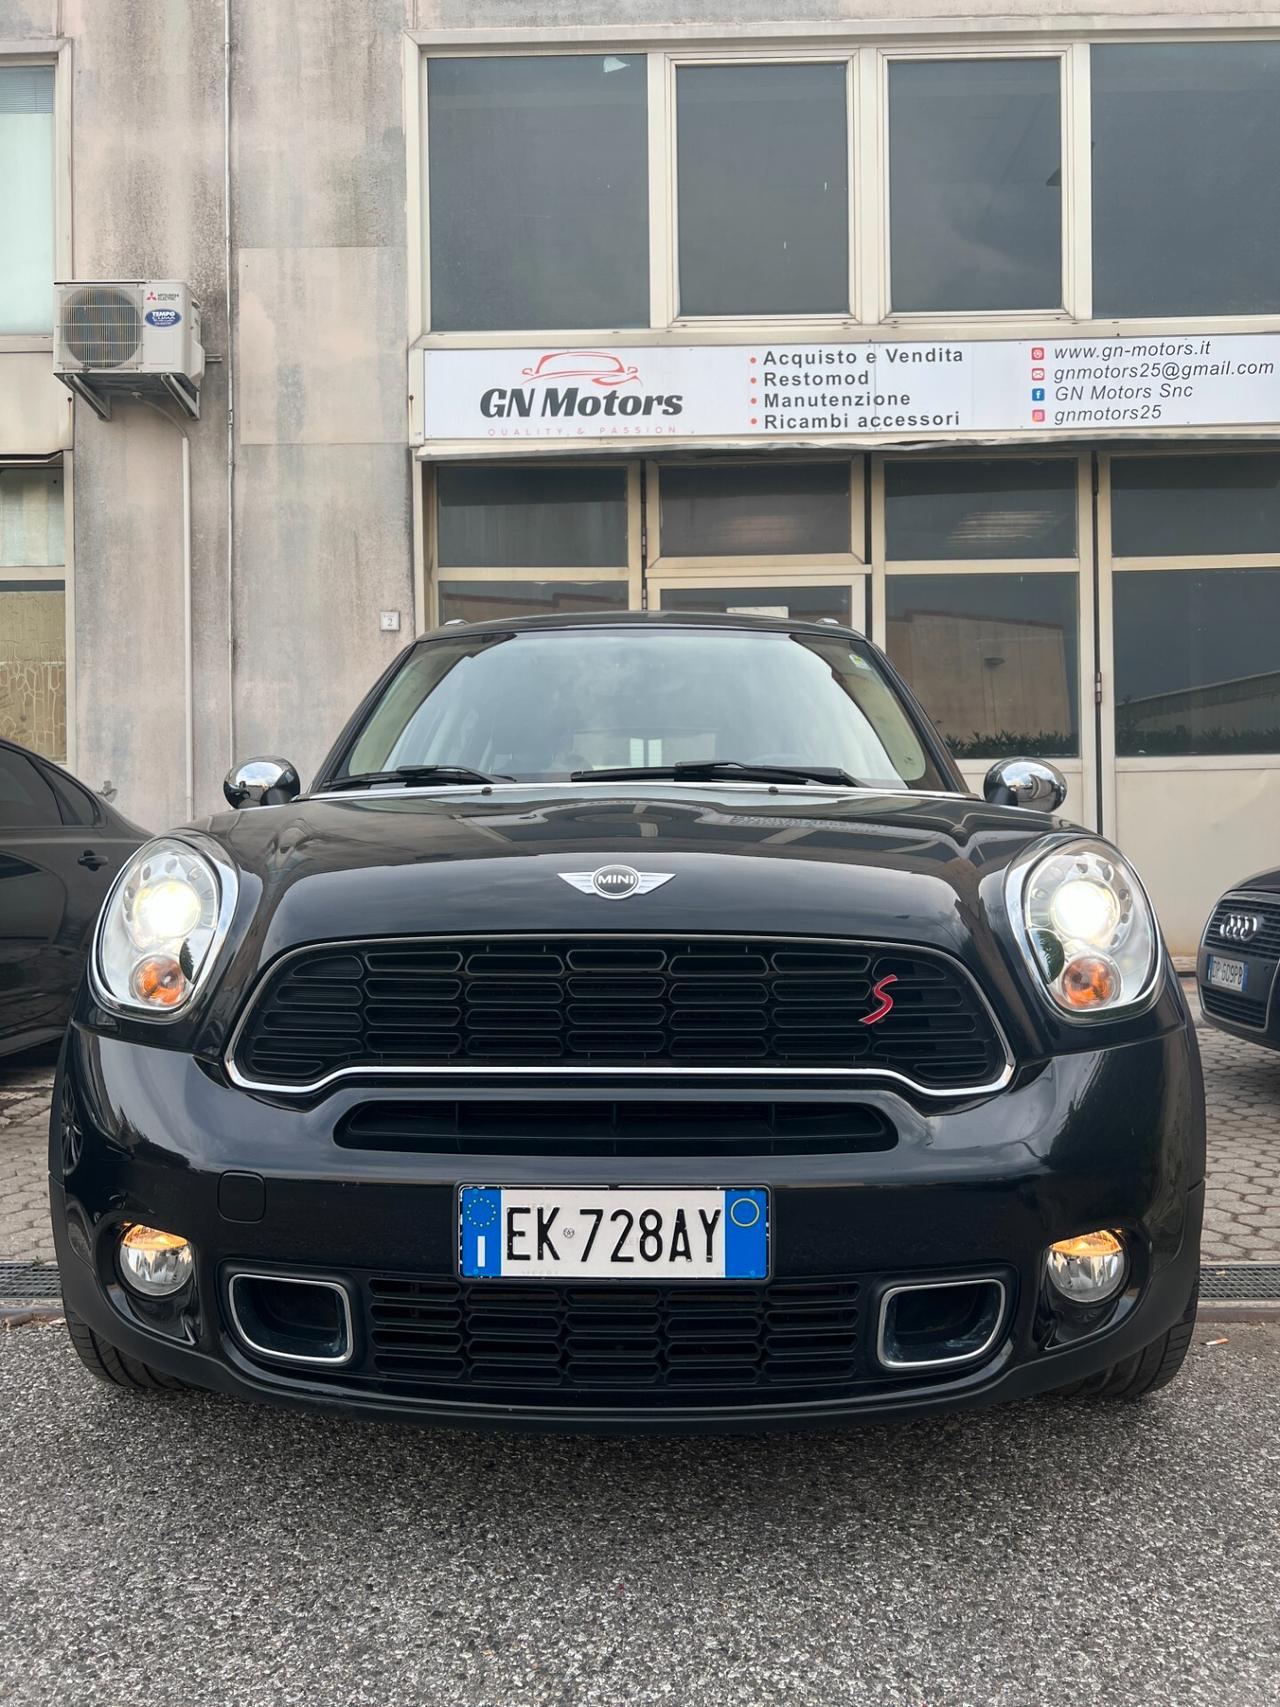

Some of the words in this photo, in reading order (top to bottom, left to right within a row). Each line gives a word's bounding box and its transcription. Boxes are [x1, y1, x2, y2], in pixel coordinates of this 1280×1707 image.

[763, 349, 857, 369] Acquisto
[866, 352, 877, 364] e
[886, 348, 963, 364] Vendita
[1054, 340, 1211, 361] www.gn-motors.it
[764, 370, 869, 387] Restomod
[1054, 361, 1274, 383] gnmotors25@gmail.com
[764, 392, 910, 408] Manutenzione
[1055, 386, 1084, 401] GN
[1090, 384, 1152, 401] Motors
[1160, 382, 1193, 398] Snc
[480, 387, 535, 418] GN
[541, 387, 683, 417] Motors
[764, 414, 848, 430] Ricambi
[858, 411, 960, 428] accessori
[1054, 404, 1162, 425] gnmotors25
[600, 426, 676, 435] PASSION
[387, 617, 393, 627] 2
[598, 874, 634, 885] MINI
[858, 974, 898, 1025] S
